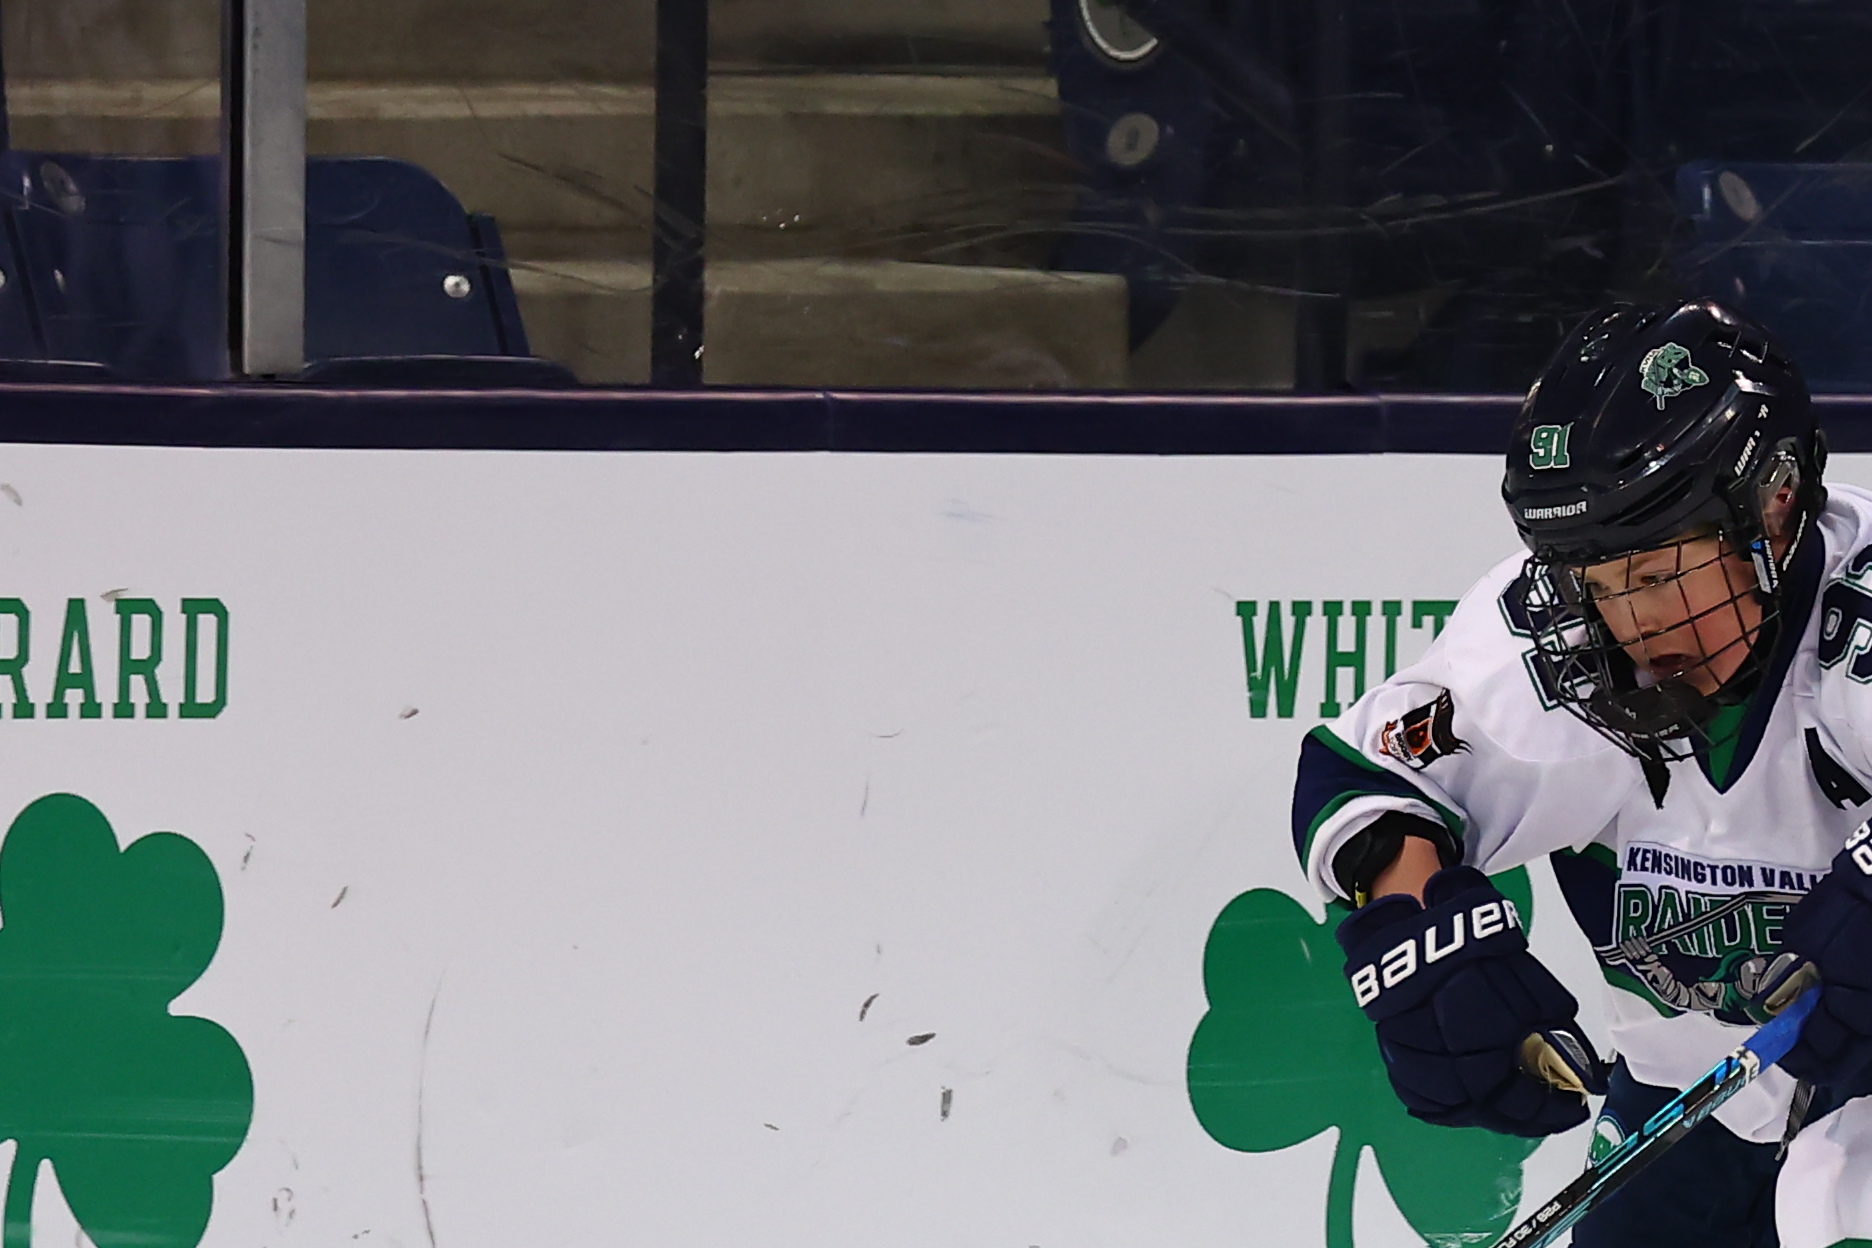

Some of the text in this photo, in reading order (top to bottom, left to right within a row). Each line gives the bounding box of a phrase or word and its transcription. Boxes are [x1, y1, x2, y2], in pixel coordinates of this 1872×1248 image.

[1530, 420, 1574, 469] 91
[1524, 501, 1587, 520] WARRIOR
[0, 597, 229, 719] RARD
[1627, 847, 1830, 891] KENSINGTON VALL
[1351, 899, 1523, 1008] BAUER
